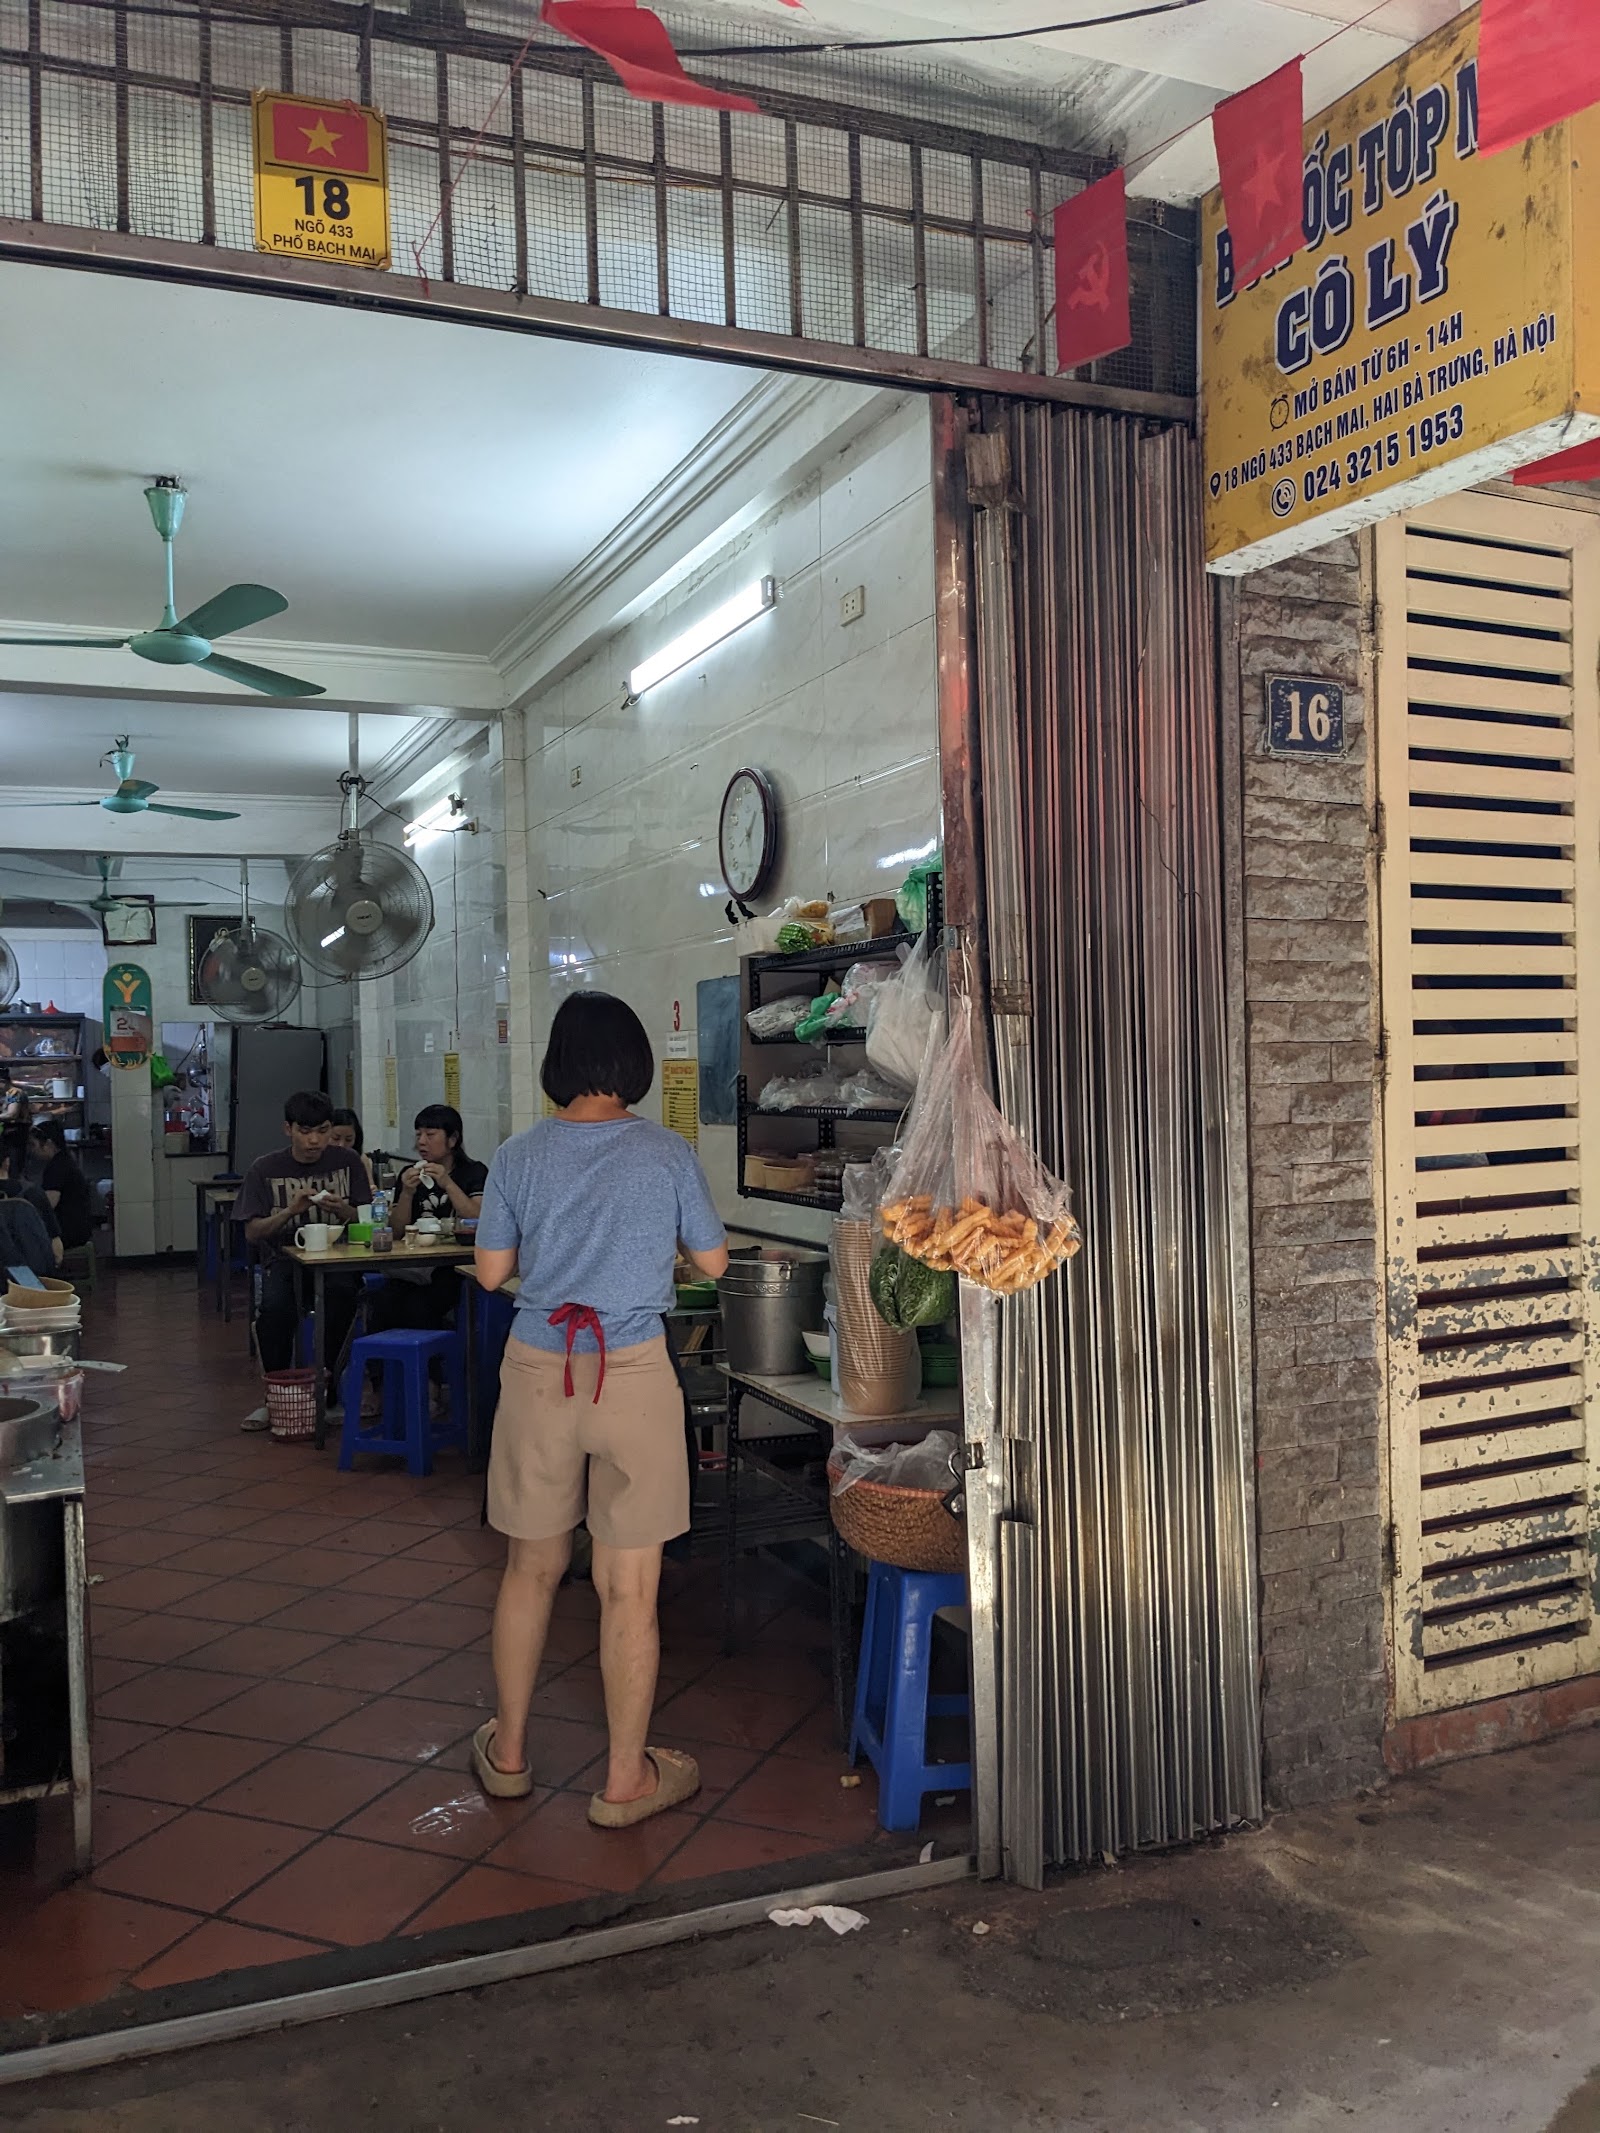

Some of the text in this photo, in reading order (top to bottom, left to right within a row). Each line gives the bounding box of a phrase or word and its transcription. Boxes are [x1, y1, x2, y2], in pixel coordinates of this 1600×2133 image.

[295, 176, 351, 220] 18
[1302, 129, 1352, 253] ỐC
[1357, 82, 1449, 216] TÓP
[273, 233, 375, 260] PHỐ BẠCH MAI
[294, 219, 354, 239] NGÕ 433
[1275, 254, 1355, 375] CÔ
[1364, 187, 1459, 332] LÝ
[1224, 313, 1556, 492] 18 NGÕ 433 BẠCH MAI, HAI BÀ TRƯNG, HÀ NỘI
[1294, 311, 1463, 420] MỞ BÁN TỪ 6H - 14H
[1303, 403, 1464, 502] 024 3215 1953
[1287, 690, 1331, 742] 16
[673, 1000, 681, 1032] 3
